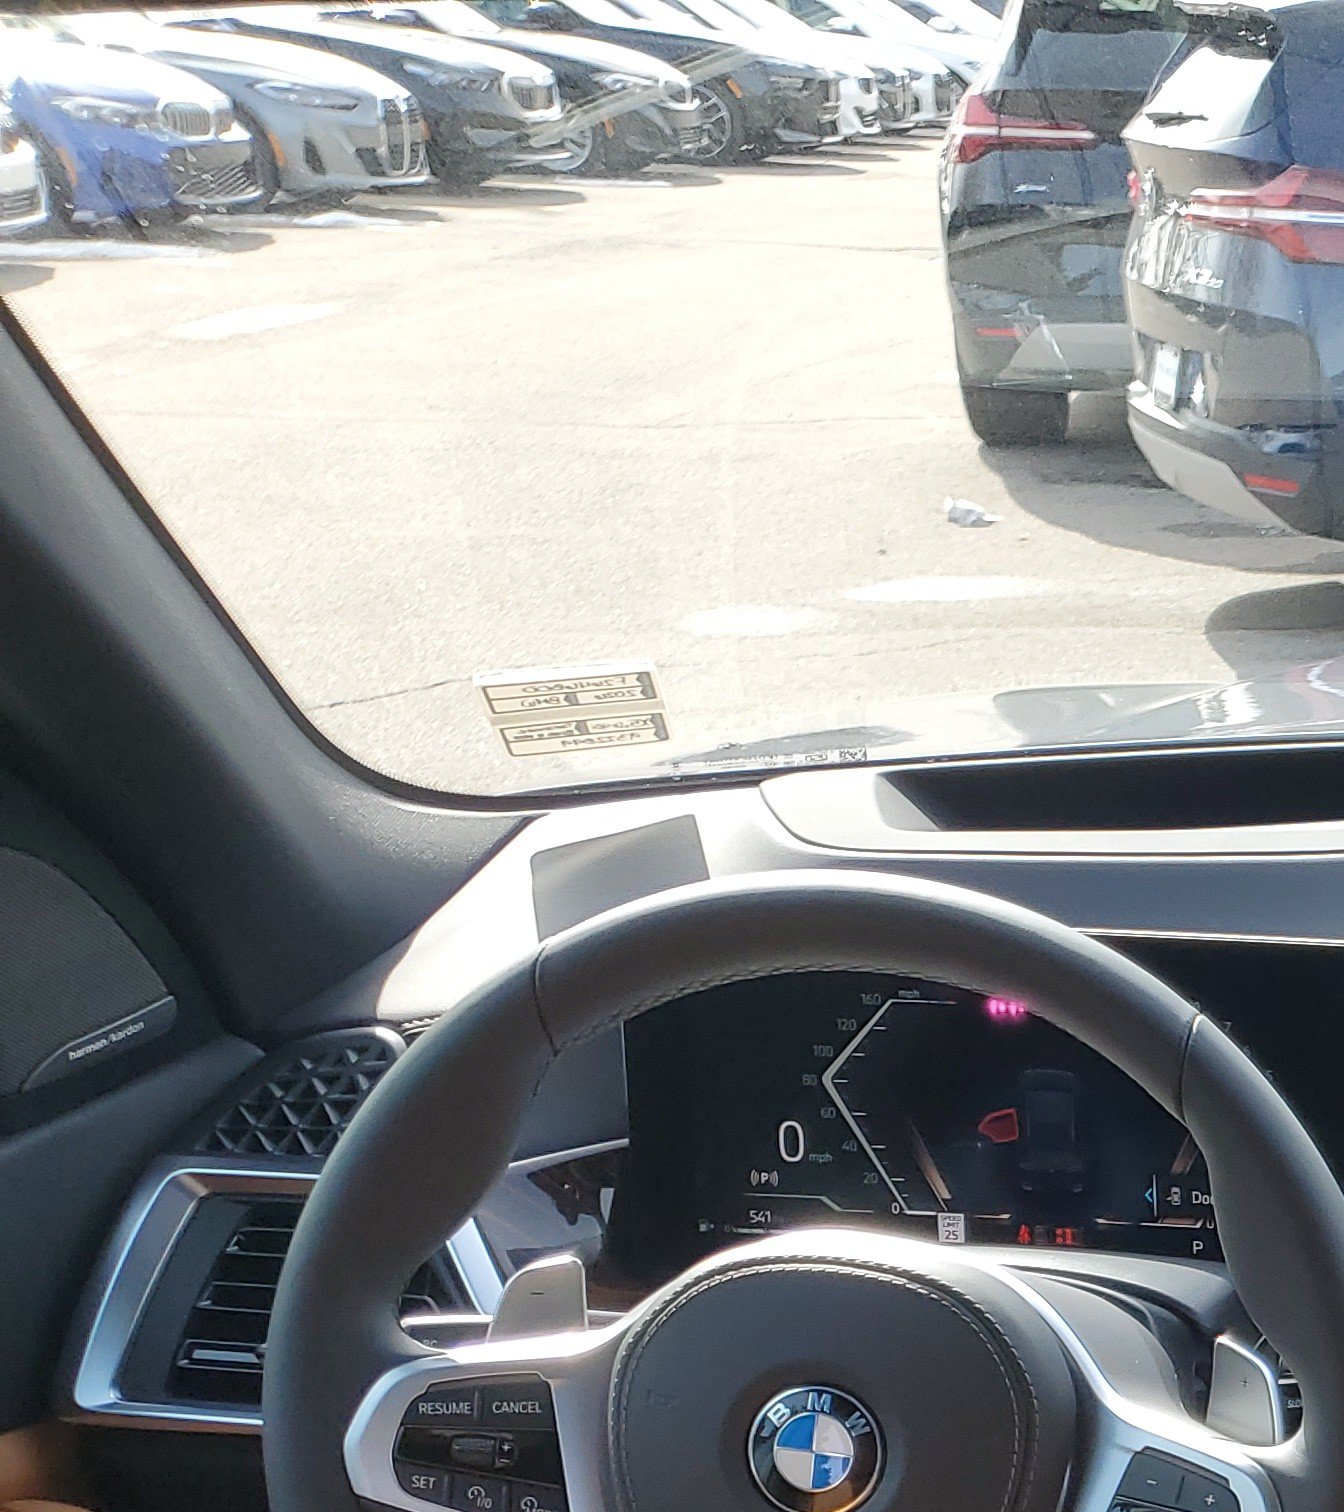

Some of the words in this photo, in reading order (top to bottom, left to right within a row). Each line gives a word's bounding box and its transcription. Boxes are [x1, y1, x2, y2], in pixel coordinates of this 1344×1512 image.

[860, 994, 882, 1006] 160
[837, 1019, 857, 1031] 120
[812, 1045, 834, 1057] 100
[820, 1107, 836, 1119] 60
[779, 1120, 804, 1162] 0
[864, 1172, 878, 1184] 20
[750, 1210, 771, 1223] 541
[944, 1230, 958, 1240] 25
[1192, 1241, 1204, 1254] P
[418, 1402, 472, 1415] RESUME
[492, 1401, 542, 1414] CANCEL
[766, 1391, 871, 1437] BMW
[411, 1475, 437, 1489] SET
